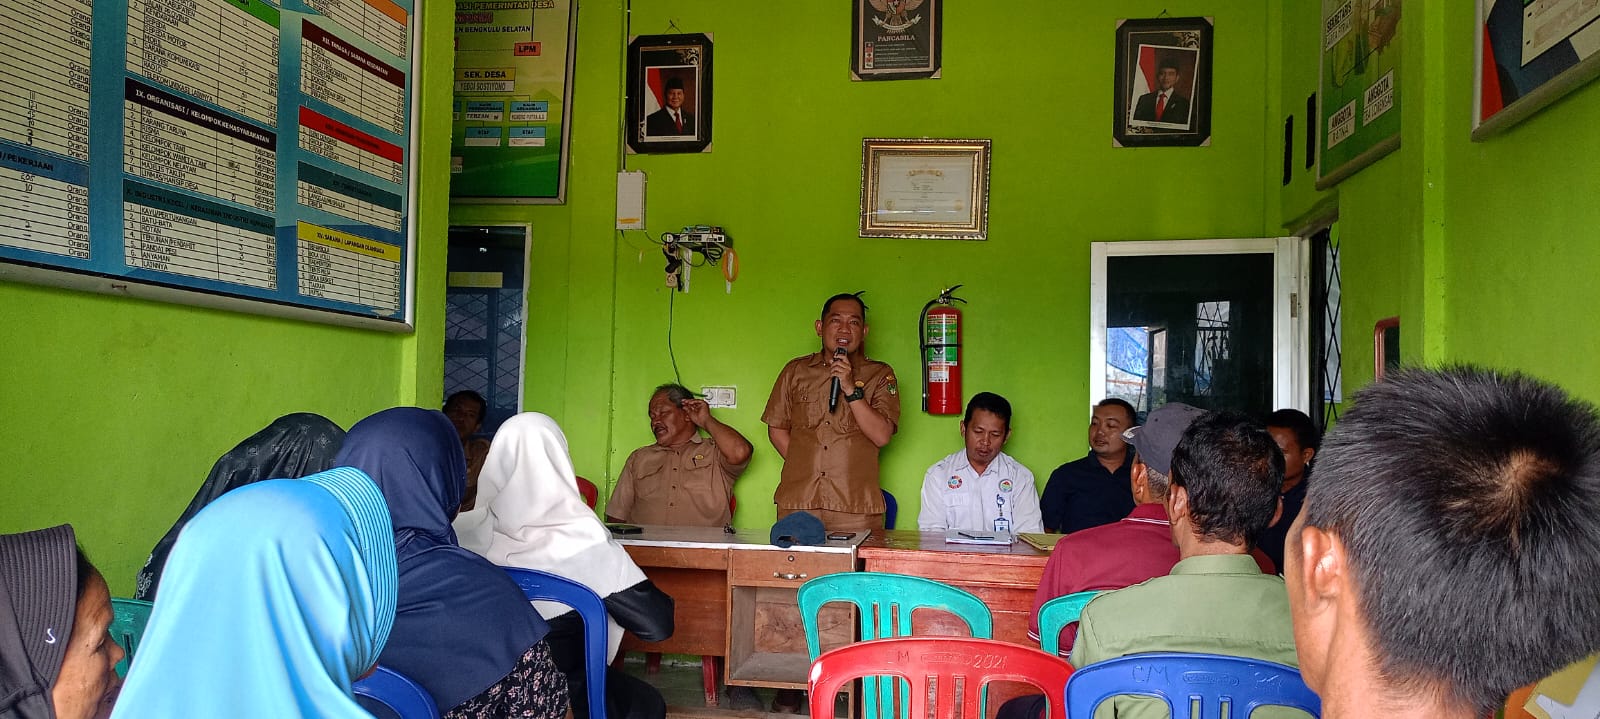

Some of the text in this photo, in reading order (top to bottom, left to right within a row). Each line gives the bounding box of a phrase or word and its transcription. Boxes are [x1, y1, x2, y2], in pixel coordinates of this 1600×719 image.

[474, 1, 529, 10] PEMERINTAH
[531, 0, 555, 9] DESA
[71, 9, 90, 24] Orang
[71, 18, 91, 32] Orang
[502, 25, 531, 33] SELATAN
[71, 36, 90, 49] Orang
[167, 34, 188, 49] MOTOR
[877, 34, 916, 42] PANCASILA
[518, 45, 537, 53] LPM
[70, 62, 90, 75] Orang
[144, 61, 163, 73] RADIO
[69, 71, 89, 84] Orang
[464, 70, 507, 79] SEK. DESA
[69, 79, 89, 92] Orang
[1367, 77, 1390, 104] ANGGOTA
[68, 105, 88, 118] Orang
[135, 89, 146, 101] IX.
[146, 93, 186, 117] ORGANISASI
[190, 109, 223, 129] KELOMPOK
[222, 120, 270, 144] KEMASYARAKATAN
[68, 114, 88, 127] Orang
[68, 123, 88, 134] Orang
[143, 117, 166, 130] KARANG
[166, 124, 188, 137] TARUNA
[143, 125, 160, 137] RISMA
[68, 131, 88, 144] Orang
[143, 133, 173, 149] KELOMPOK
[68, 140, 88, 152] Orang
[143, 143, 172, 159] KELOMPOK
[68, 149, 88, 161] Orang
[8, 153, 54, 171] PEKERJAAN
[142, 152, 172, 167] KELOMPOK
[173, 160, 198, 174] NELAYAN
[67, 185, 88, 195] Orang
[67, 194, 88, 205] Orang
[68, 203, 88, 214] Orang
[68, 211, 88, 223] Orang
[142, 215, 173, 228] BATU-BATA
[68, 222, 88, 232] Orang
[142, 224, 162, 234] ROTAN
[68, 231, 88, 241] Orang
[68, 240, 89, 250] Orang
[143, 243, 164, 253] PANDAI
[69, 249, 89, 259] Orang
[143, 252, 170, 262] ANYAMAN
[144, 260, 169, 271] LAINNYA
